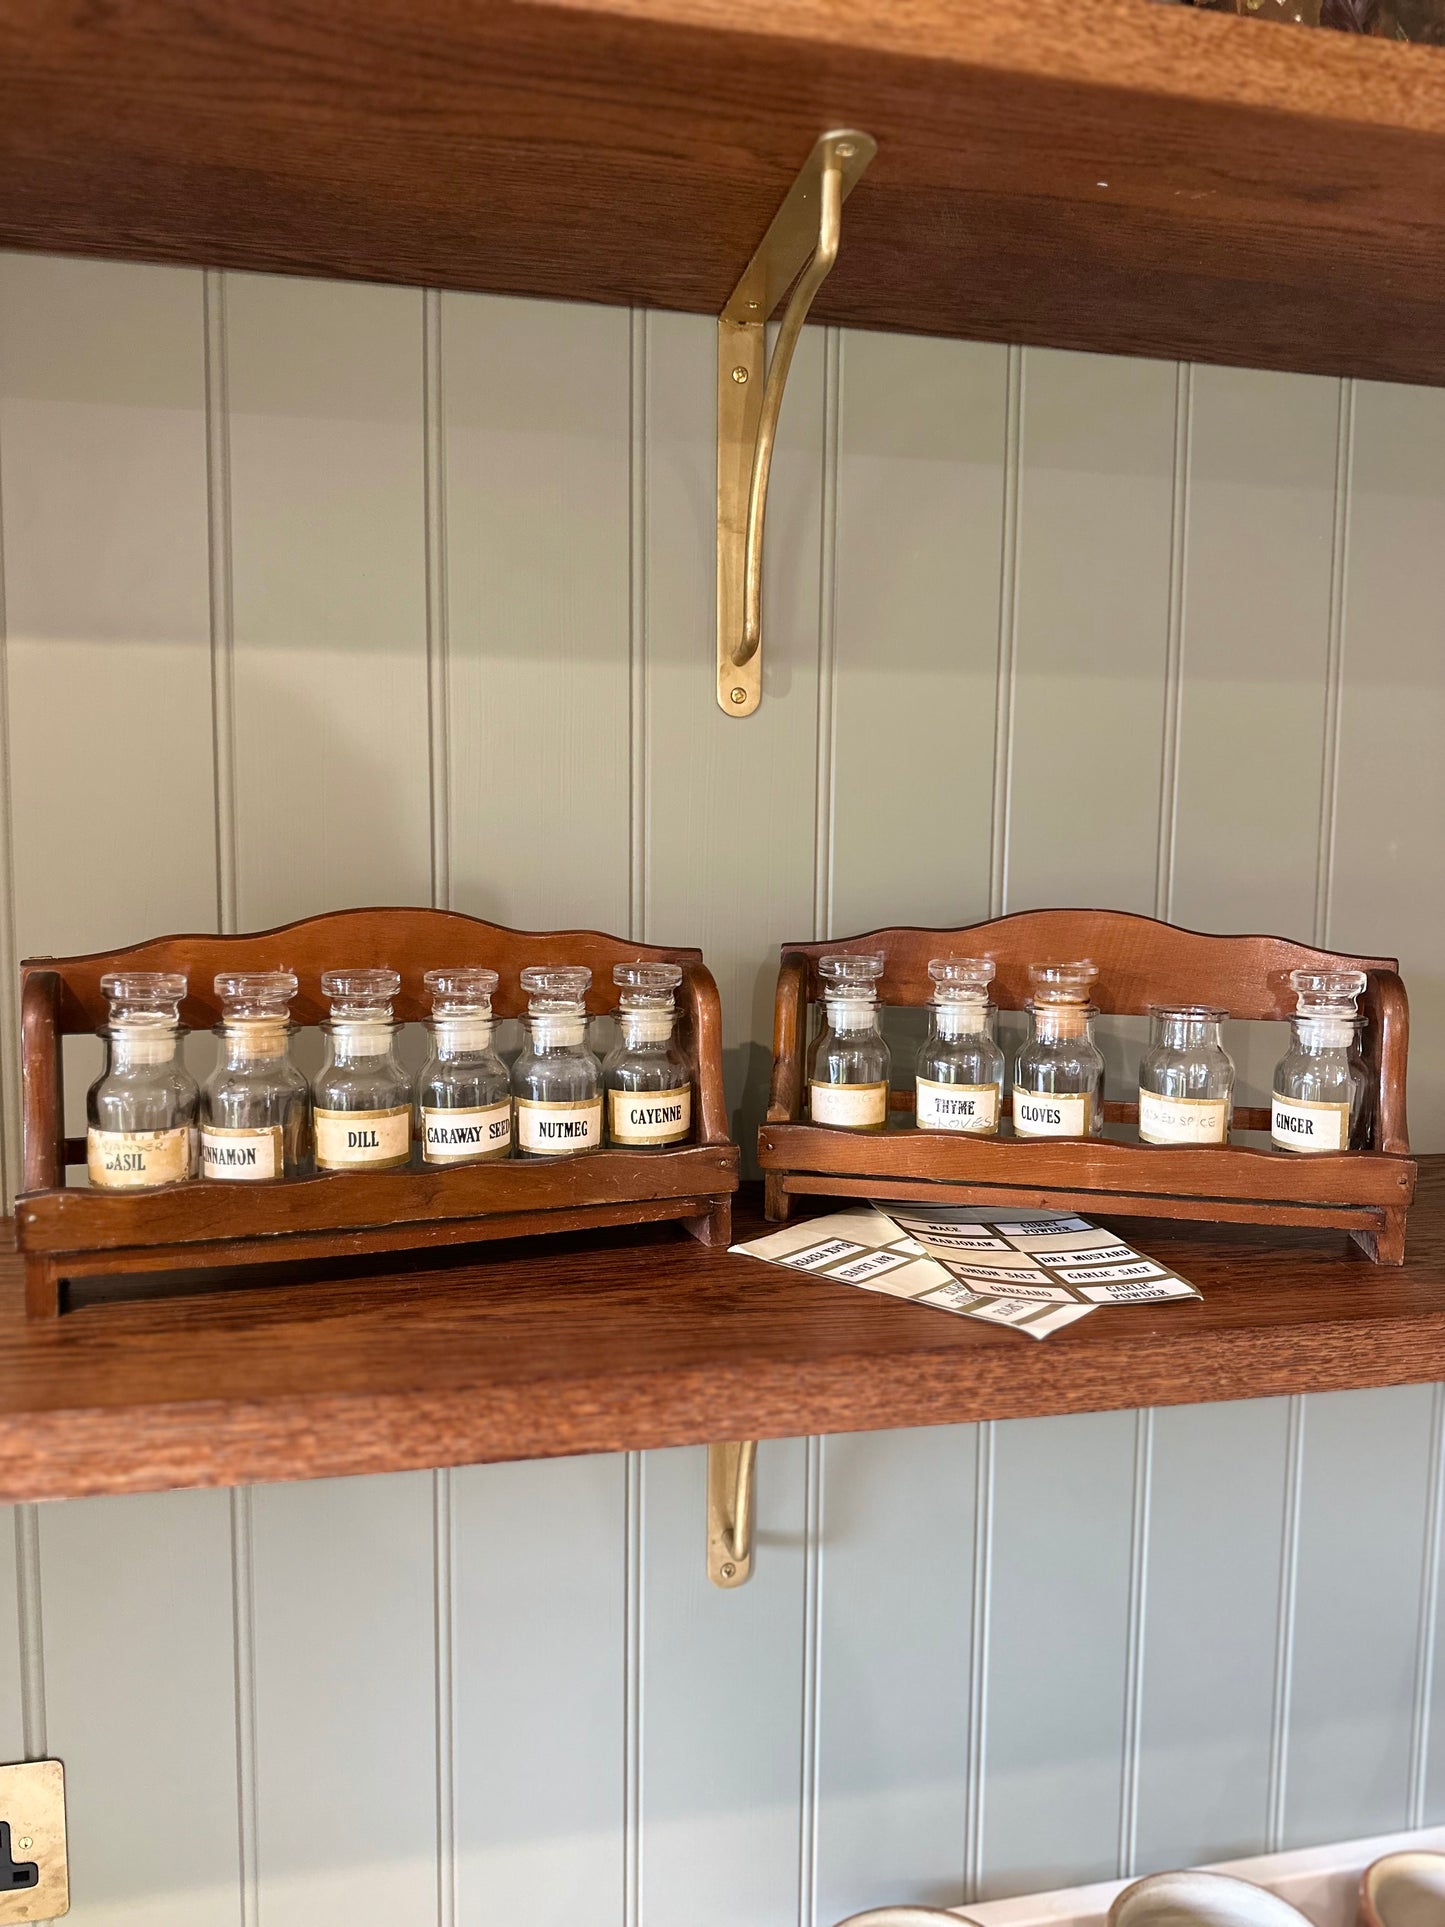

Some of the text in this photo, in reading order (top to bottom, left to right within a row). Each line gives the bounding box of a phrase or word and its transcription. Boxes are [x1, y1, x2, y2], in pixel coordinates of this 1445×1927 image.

[935, 1098, 976, 1115] THYME
[1021, 1104, 1061, 1124] CLOVES
[630, 1105, 682, 1124] CAYENNE
[1142, 1106, 1216, 1128] MXED SPCE
[539, 1120, 588, 1138] NUTMEG
[1276, 1112, 1314, 1135] GINGER
[348, 1131, 379, 1148] DILL
[427, 1126, 483, 1143] CARAWAY
[928, 1225, 961, 1233] MACE
[1023, 1226, 1073, 1234] POWDER
[927, 1236, 995, 1248] MARJORAM
[1039, 1249, 1132, 1263] DRY MUSTARD
[960, 1266, 1038, 1280] ONION SALT
[1067, 1265, 1151, 1280] GARLIC SALT
[989, 1284, 1053, 1297] OREGANO
[1105, 1282, 1155, 1292] GARLIC
[1111, 1288, 1169, 1301] POWDER
